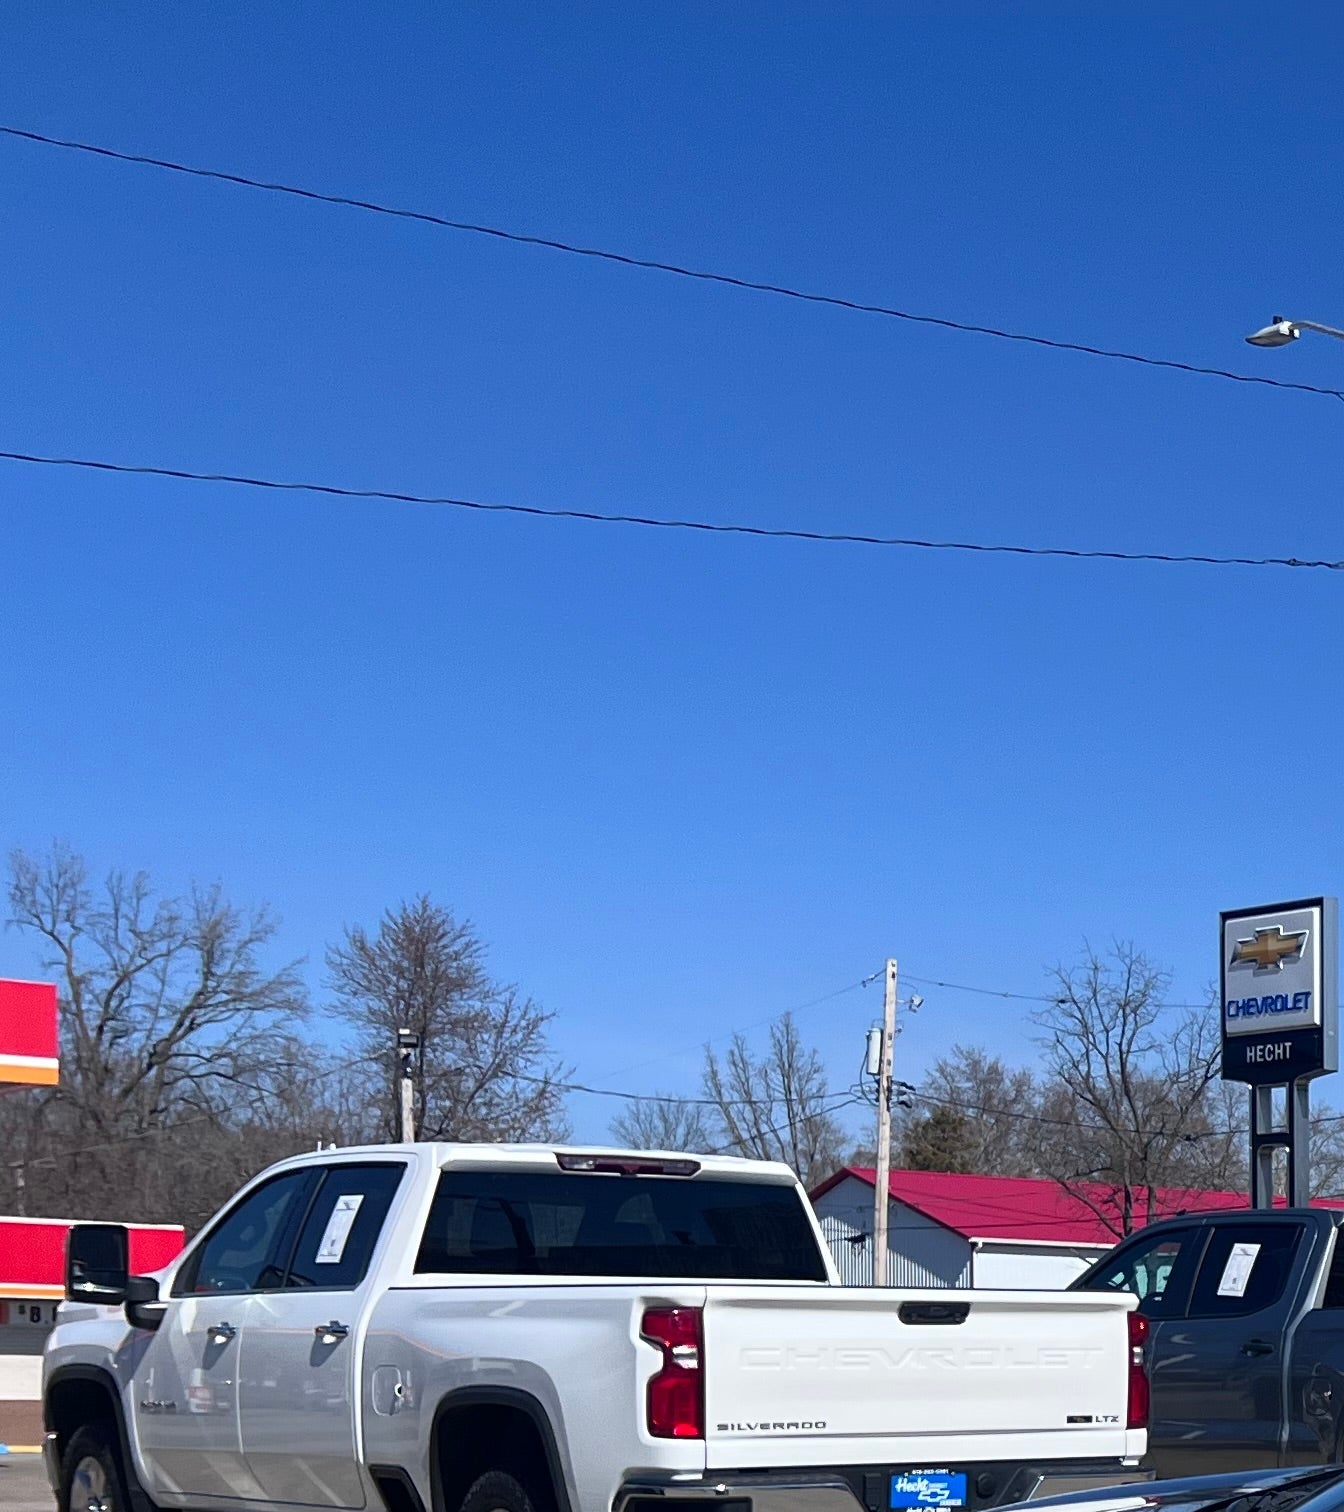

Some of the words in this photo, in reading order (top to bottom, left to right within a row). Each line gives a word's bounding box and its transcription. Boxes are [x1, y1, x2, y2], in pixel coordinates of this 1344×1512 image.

[1227, 991, 1311, 1018] CHEVROLET
[1246, 1042, 1293, 1063] HECHT
[738, 1346, 1104, 1371] CHEVROLET
[717, 1421, 827, 1431] SILVERADO
[1095, 1415, 1119, 1423] LTZ
[895, 1477, 929, 1493] Hecht
